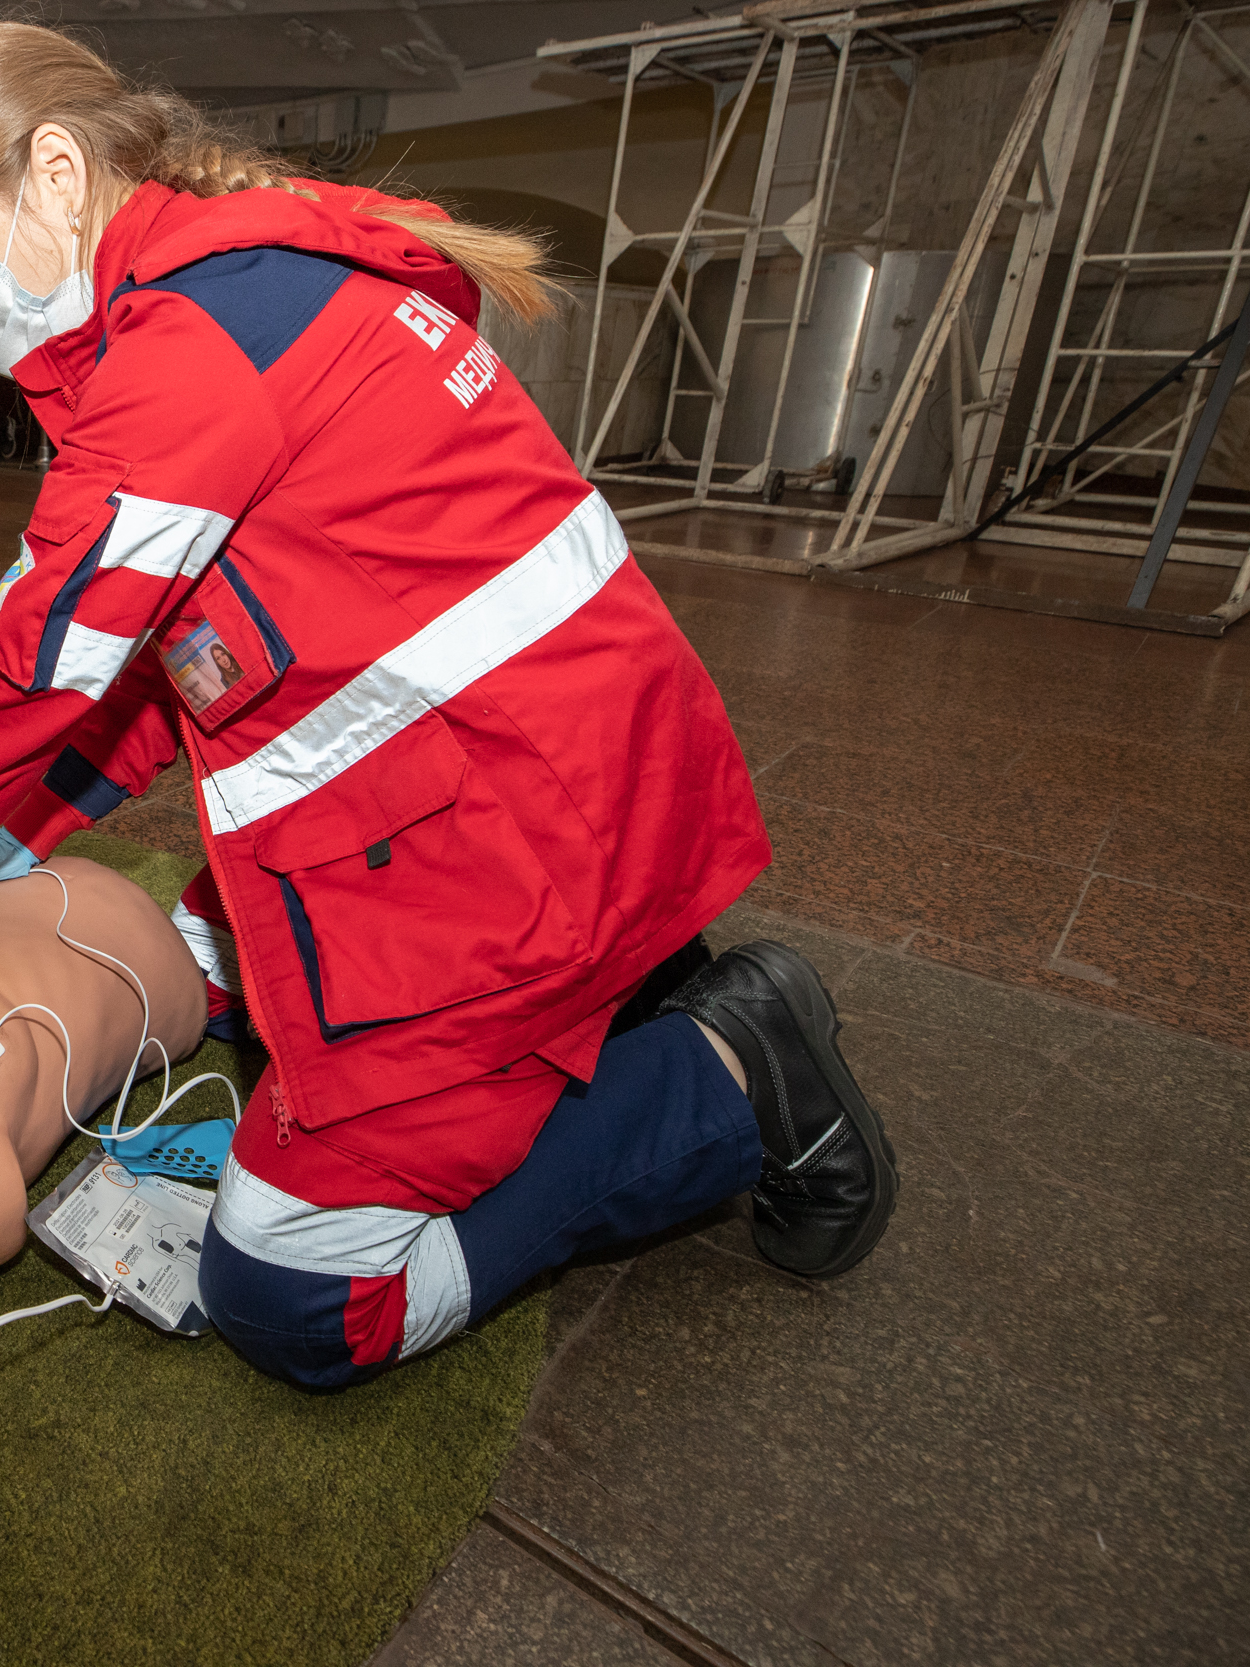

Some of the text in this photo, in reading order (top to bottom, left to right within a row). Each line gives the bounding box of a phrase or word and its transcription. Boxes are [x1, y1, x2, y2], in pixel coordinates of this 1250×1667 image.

[393, 289, 459, 351] ЕК
[89, 1172, 101, 1185] 9131
[156, 1182, 210, 1209] ALONG DOTTED LINE
[121, 1243, 138, 1263] CARDIAC
[154, 1272, 165, 1287] Science
